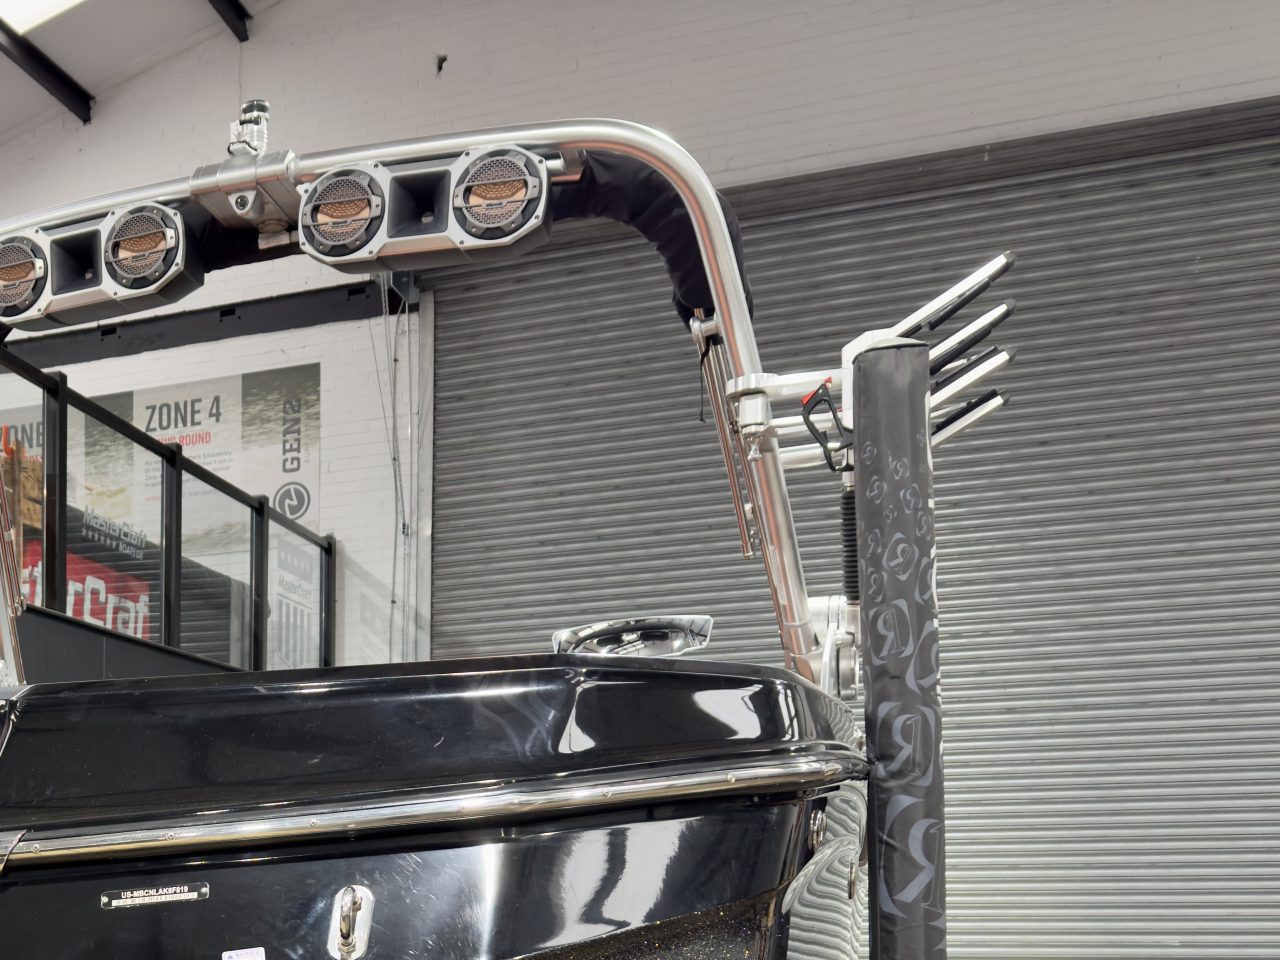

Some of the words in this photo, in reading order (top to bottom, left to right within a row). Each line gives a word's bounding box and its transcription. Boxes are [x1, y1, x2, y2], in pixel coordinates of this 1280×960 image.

[145, 398, 202, 432] ZONE
[208, 395, 222, 423] 4
[179, 431, 211, 446] ROUND
